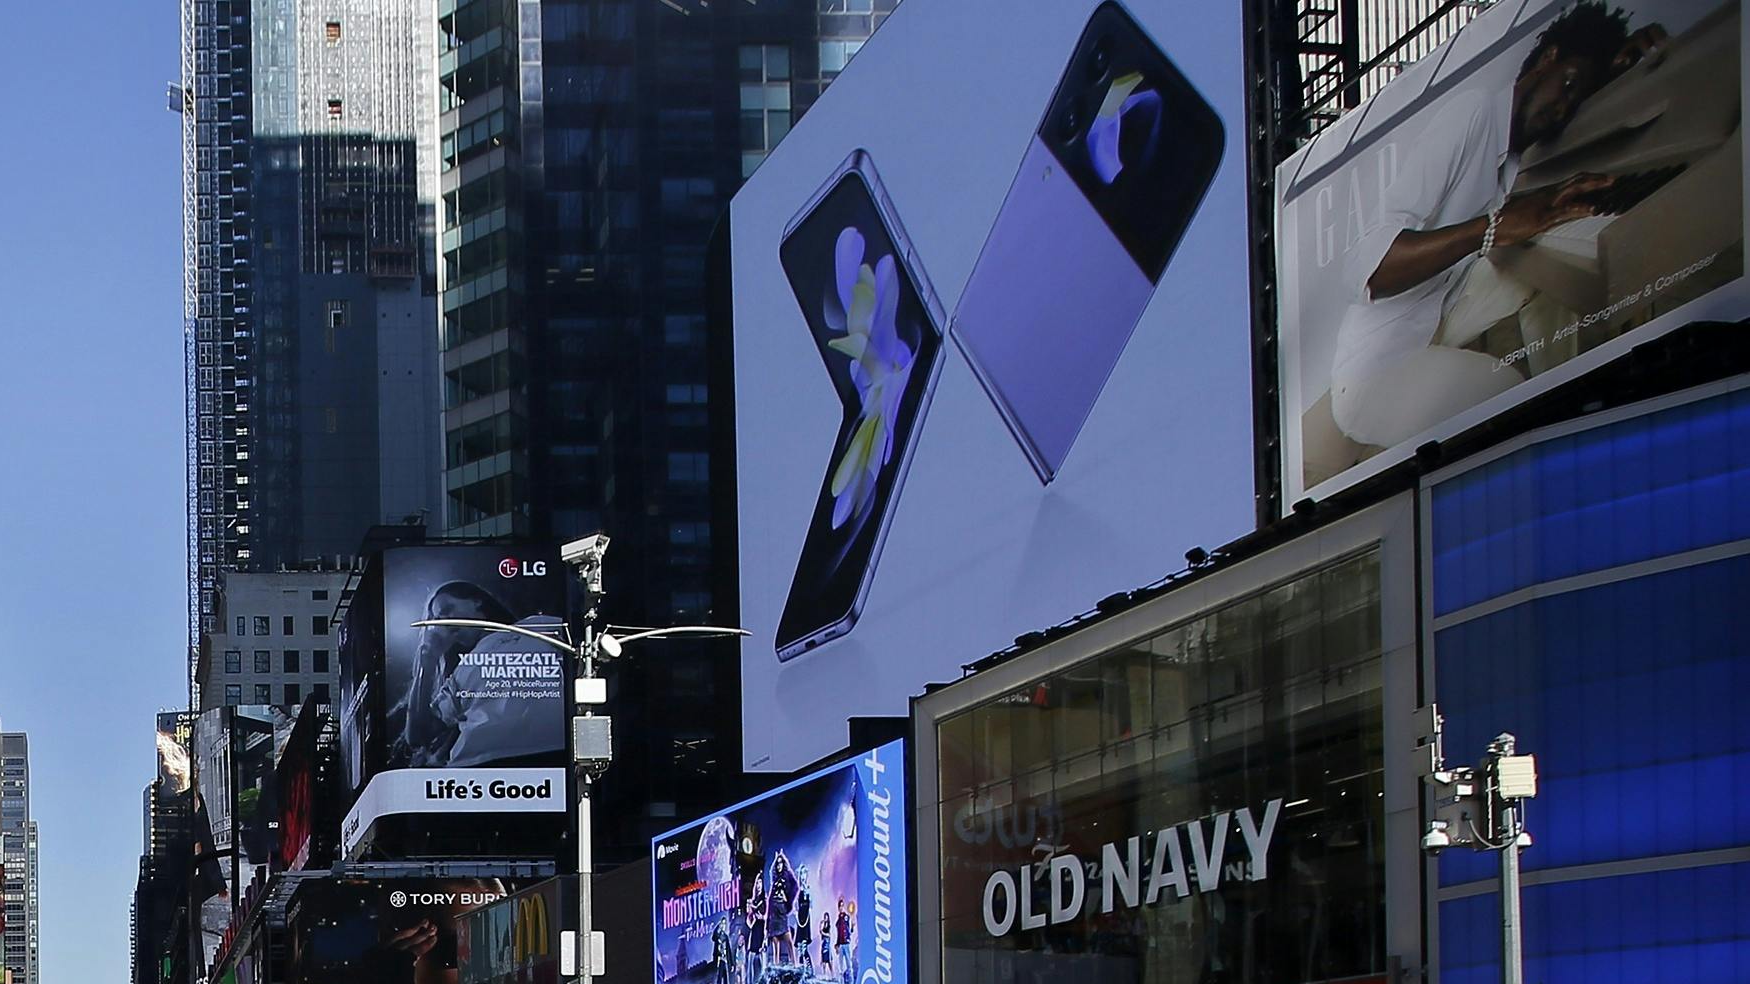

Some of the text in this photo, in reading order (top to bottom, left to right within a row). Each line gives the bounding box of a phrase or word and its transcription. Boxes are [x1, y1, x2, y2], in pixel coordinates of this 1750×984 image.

[1315, 141, 1400, 268] GAP
[1491, 253, 1717, 374] LABRINTH Artist-Songwriter & Composer
[522, 561, 547, 576] LG
[458, 653, 560, 666] XIUHTEZCATL
[481, 666, 560, 678] MARTINEZ
[486, 680, 499, 689] Age
[513, 680, 560, 688] #VoiceRunner
[456, 690, 561, 700] #ClimateActivist #HipHopArtist
[489, 778, 552, 800] Good
[982, 798, 1283, 938] OLD NAVY
[410, 893, 457, 905] TORY
[663, 876, 741, 930] MONSTER HIGH
